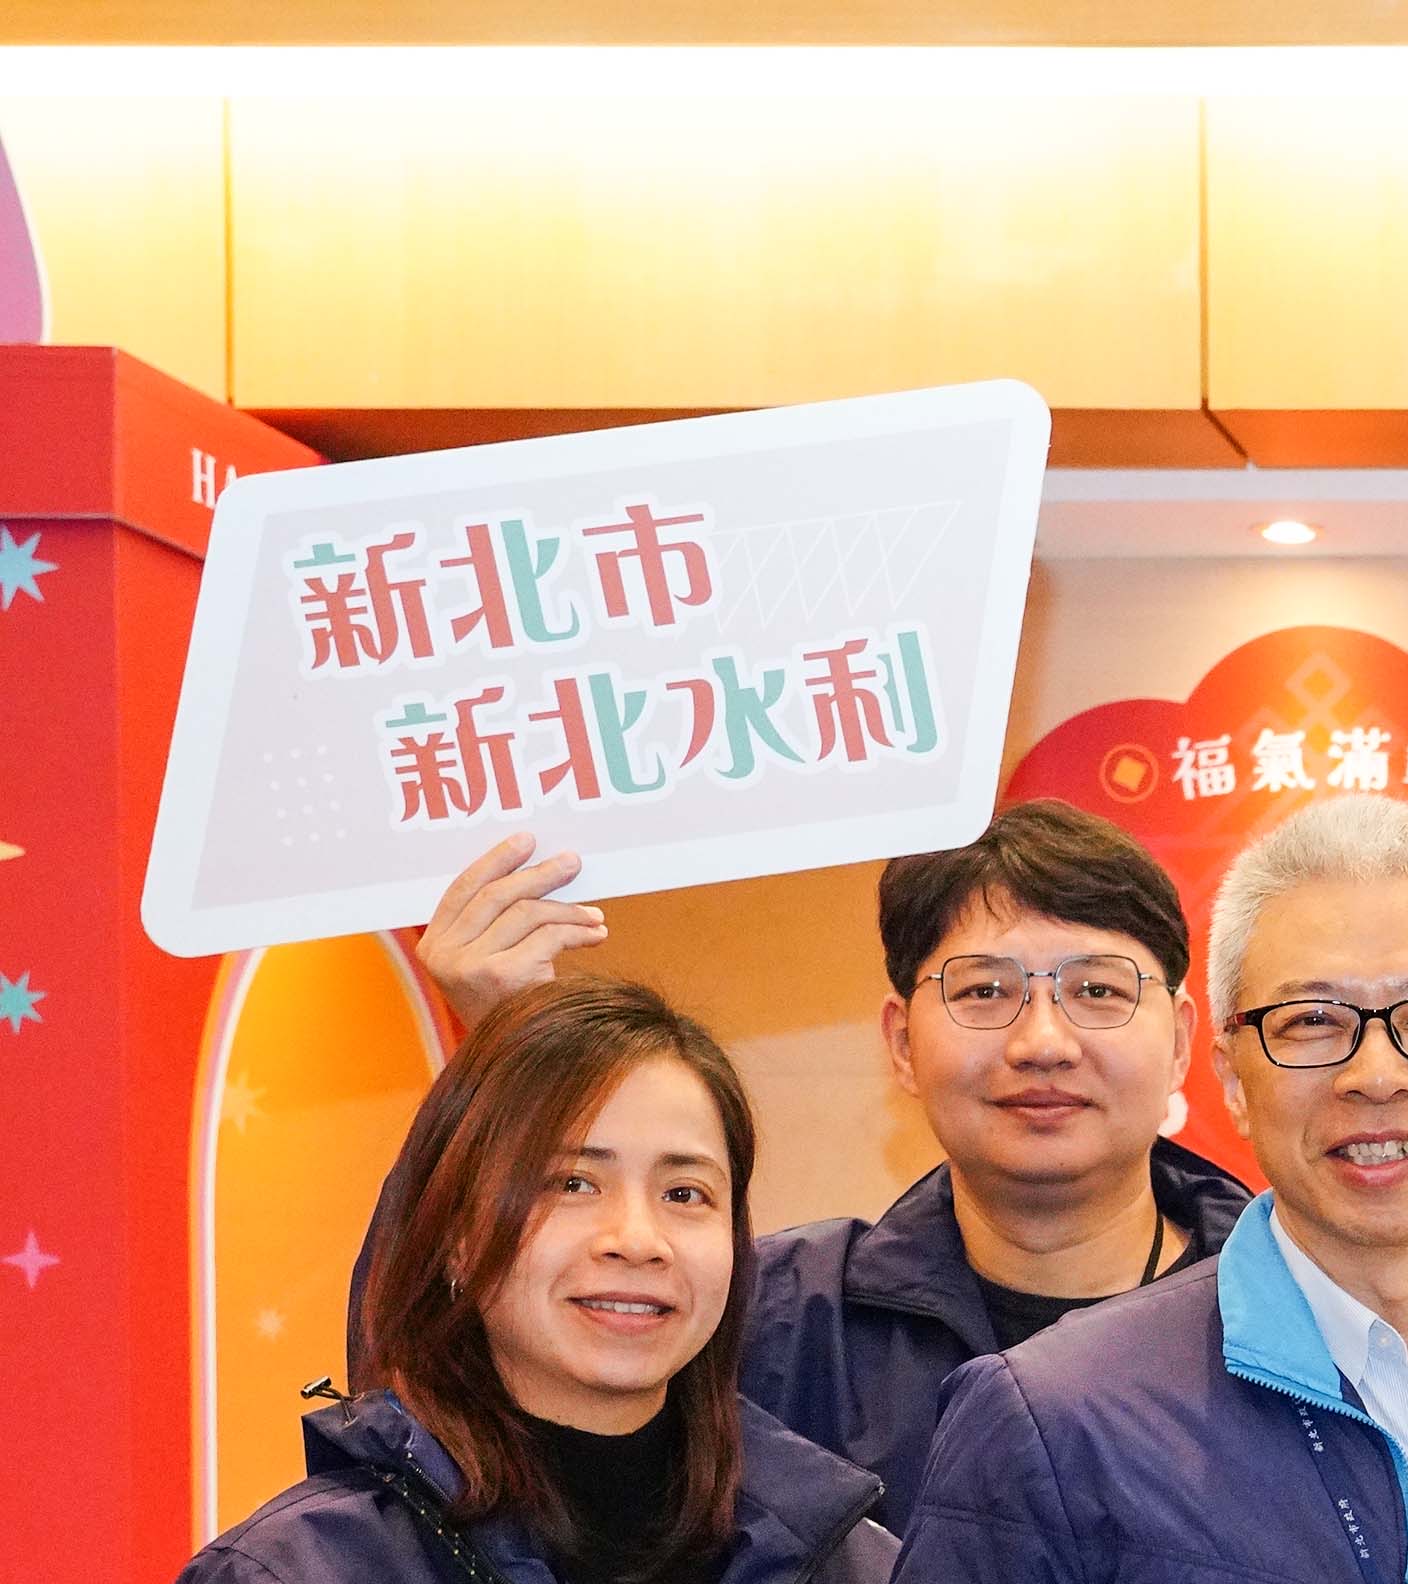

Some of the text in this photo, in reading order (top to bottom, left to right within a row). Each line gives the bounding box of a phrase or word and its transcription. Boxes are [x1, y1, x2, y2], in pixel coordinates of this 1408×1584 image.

[293, 503, 713, 670] 新北市
[385, 630, 937, 822] 新北水利
[1297, 1399, 1325, 1452] 新北市政
[1338, 1498, 1370, 1559] 新北市政府
